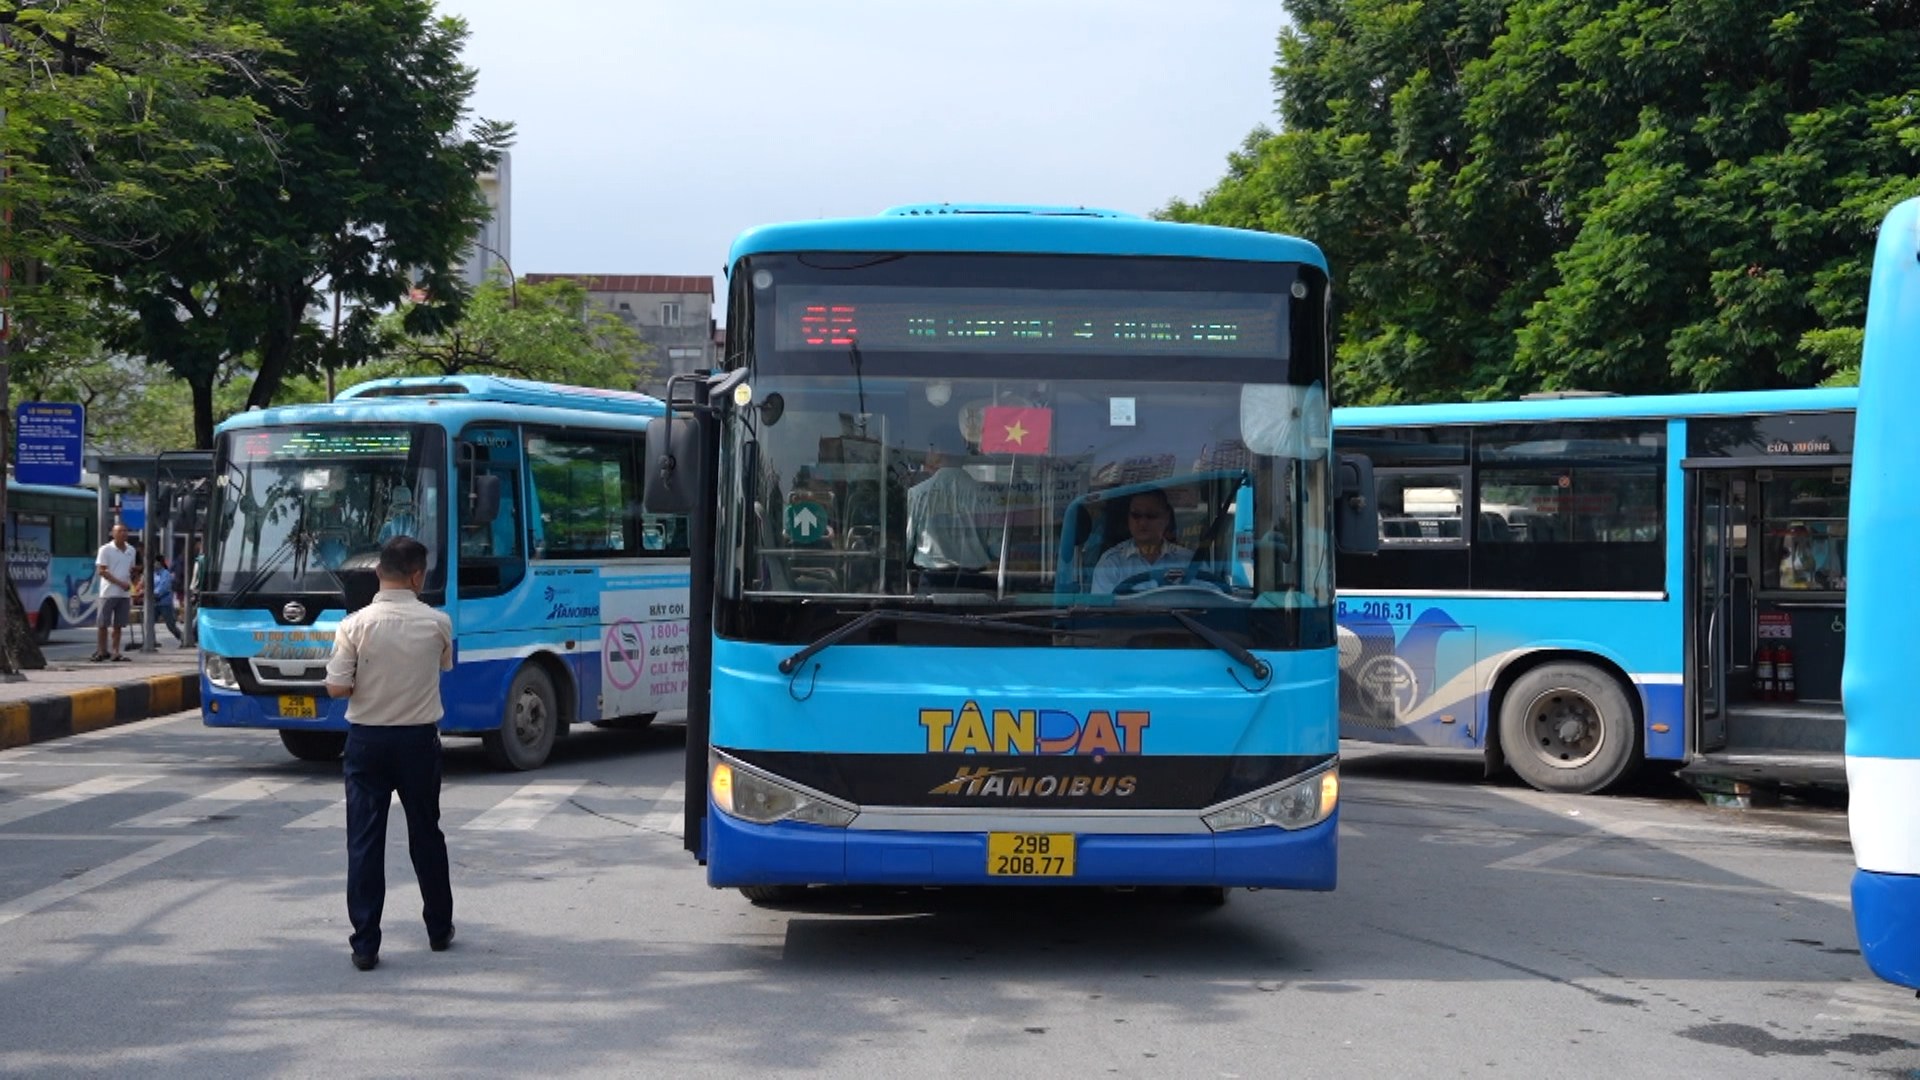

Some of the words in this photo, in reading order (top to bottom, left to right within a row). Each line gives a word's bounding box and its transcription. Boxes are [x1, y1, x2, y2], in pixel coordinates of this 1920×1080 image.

[546, 603, 599, 620] HANOIBUS
[1338, 601, 1347, 619] B
[1363, 601, 1411, 620] 206.31
[681, 679, 688, 692] P
[928, 767, 1137, 797] HANOIBUS
[1013, 835, 1050, 854] 29B
[997, 857, 1065, 875] 208.77
